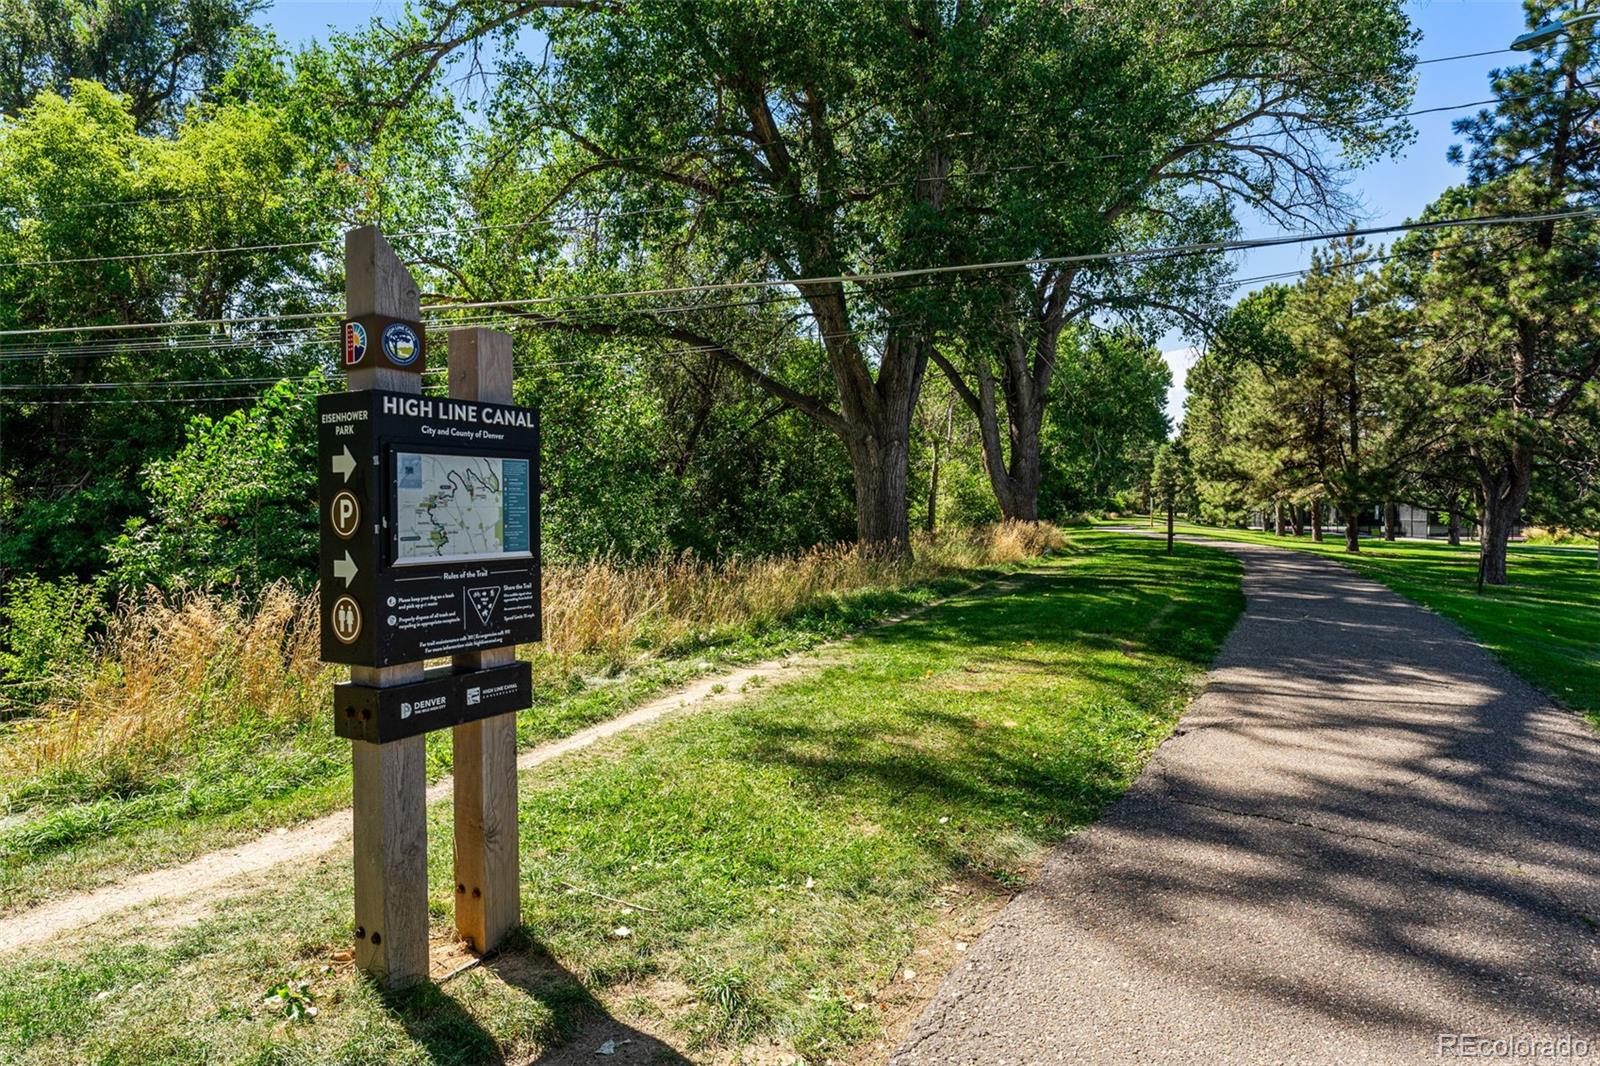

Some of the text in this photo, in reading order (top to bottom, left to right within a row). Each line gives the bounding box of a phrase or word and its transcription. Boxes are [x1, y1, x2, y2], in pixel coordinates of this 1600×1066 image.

[321, 410, 368, 424] EISENHOWER
[383, 396, 535, 428] HIGH LINE CANAL
[335, 425, 354, 436] PARK
[421, 425, 505, 440] City and County of Denver
[340, 499, 353, 529] P
[443, 569, 488, 580] Rules of the Trail
[414, 696, 446, 710] DENVER
